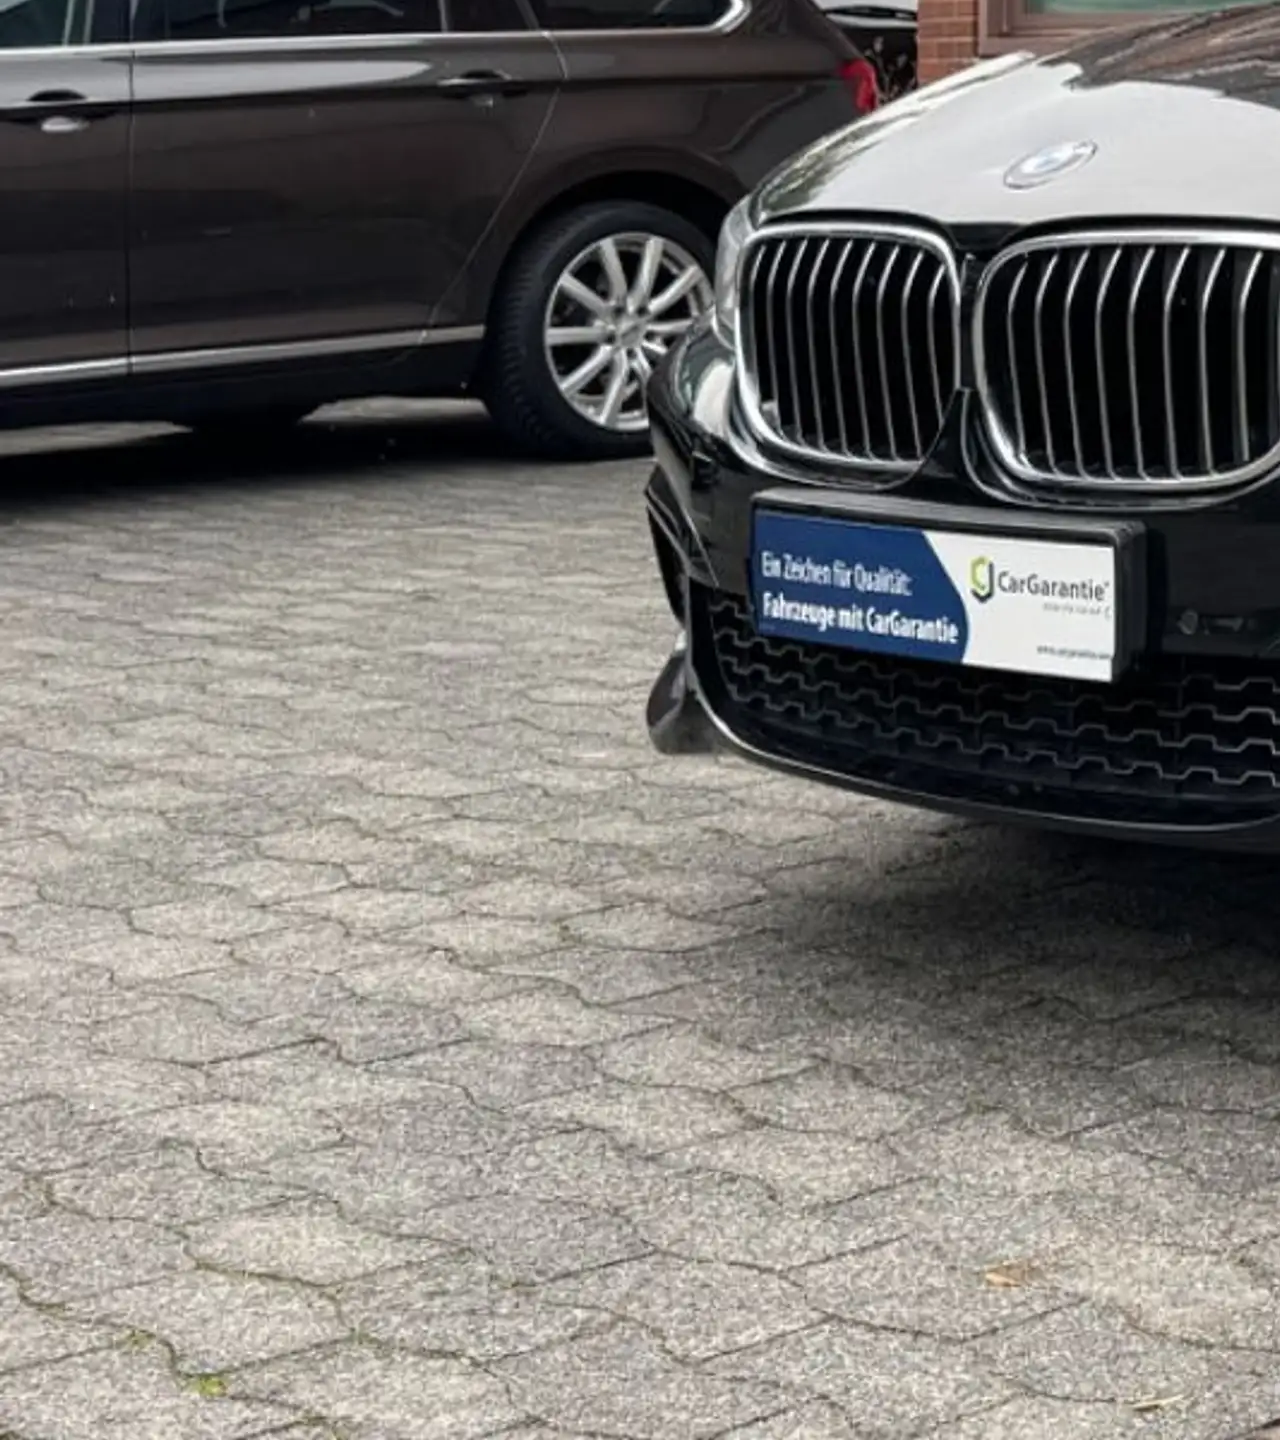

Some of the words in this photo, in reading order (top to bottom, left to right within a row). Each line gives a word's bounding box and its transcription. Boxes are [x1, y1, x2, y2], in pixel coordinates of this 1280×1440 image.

[762, 550, 781, 578] Ein
[783, 553, 831, 585] Zeichen
[833, 559, 851, 588] für
[763, 590, 836, 632] Fahrzeuge
[838, 603, 865, 632] mit
[866, 606, 960, 645] CarGarantie
